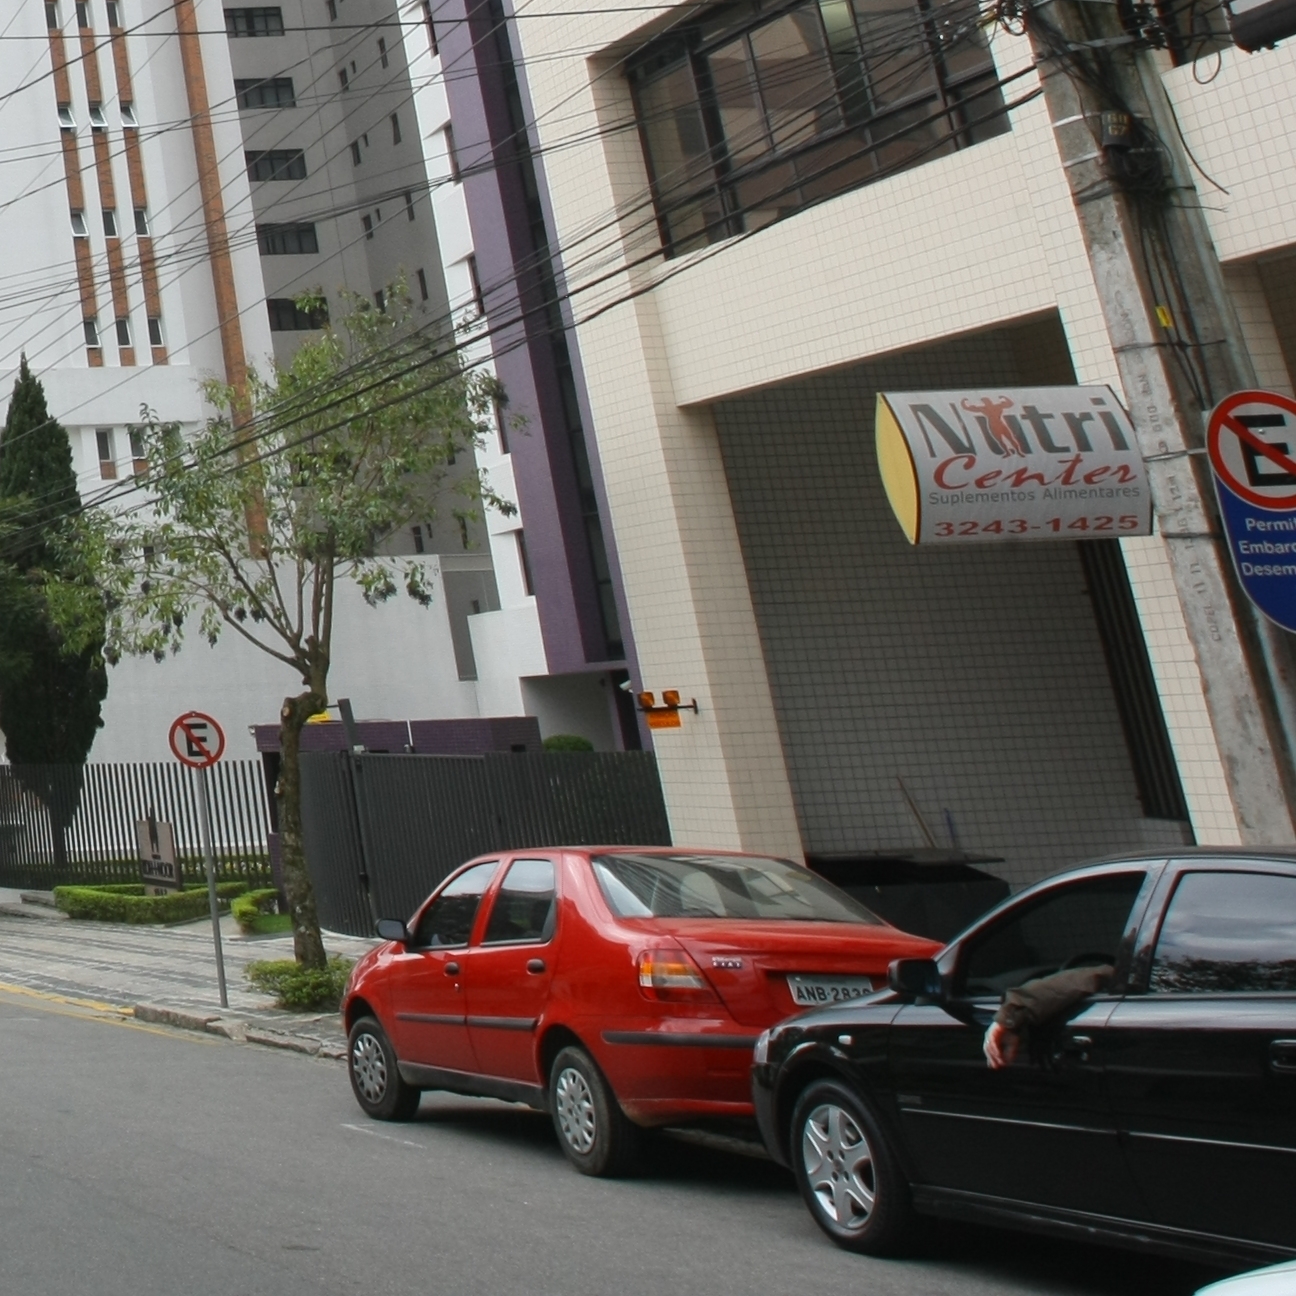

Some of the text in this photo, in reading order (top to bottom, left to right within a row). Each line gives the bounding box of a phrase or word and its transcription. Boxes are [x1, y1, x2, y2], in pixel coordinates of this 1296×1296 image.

[909, 397, 1130, 458] Nutri
[933, 452, 1137, 490] Center
[929, 486, 1140, 506] Suplementos Alimentares
[934, 515, 1139, 537] 3243-1425
[185, 723, 211, 756] E
